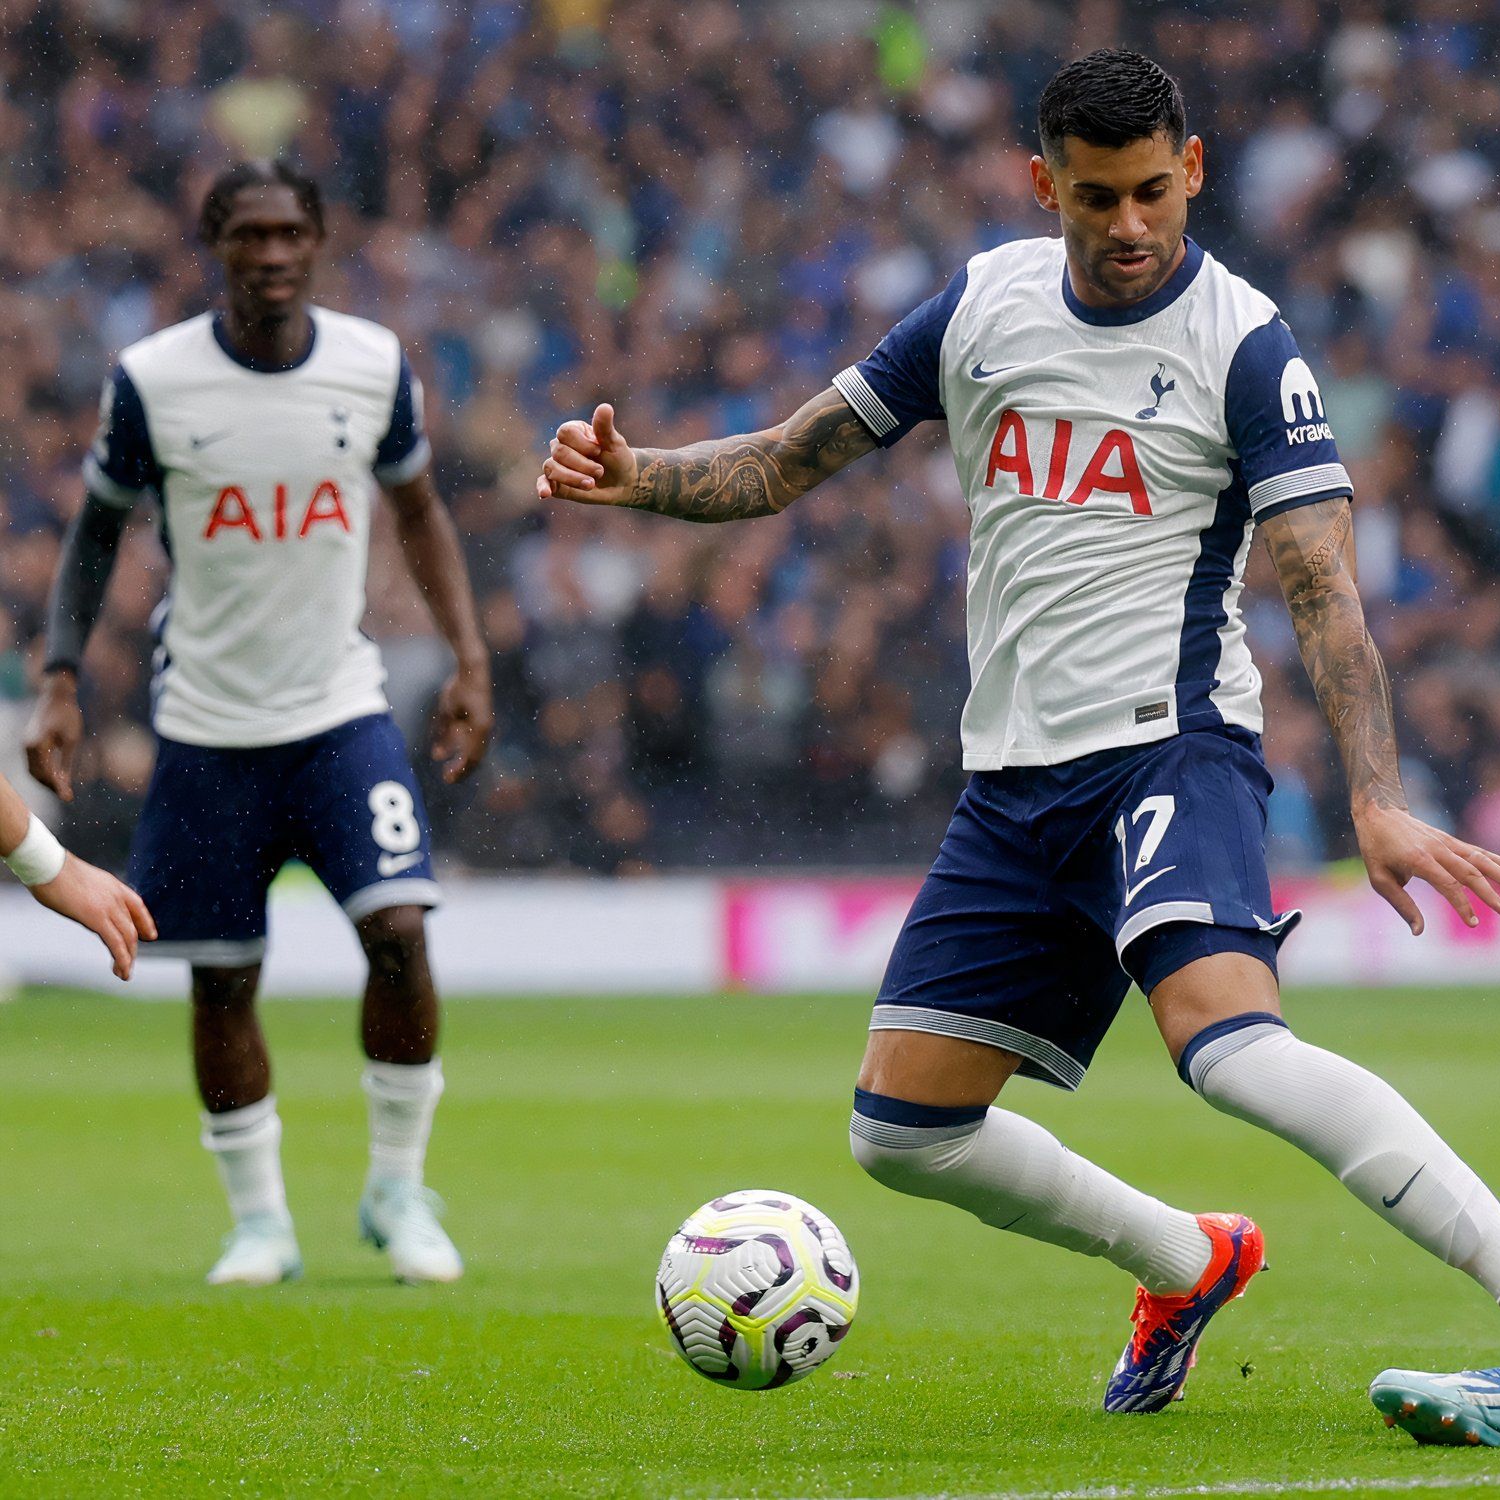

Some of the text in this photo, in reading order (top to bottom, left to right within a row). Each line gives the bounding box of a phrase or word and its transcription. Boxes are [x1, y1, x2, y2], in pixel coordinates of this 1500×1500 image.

[985, 408, 1153, 517] AIA
[1286, 422, 1334, 446] krak
[205, 480, 351, 541] AIA
[368, 780, 421, 854] 8
